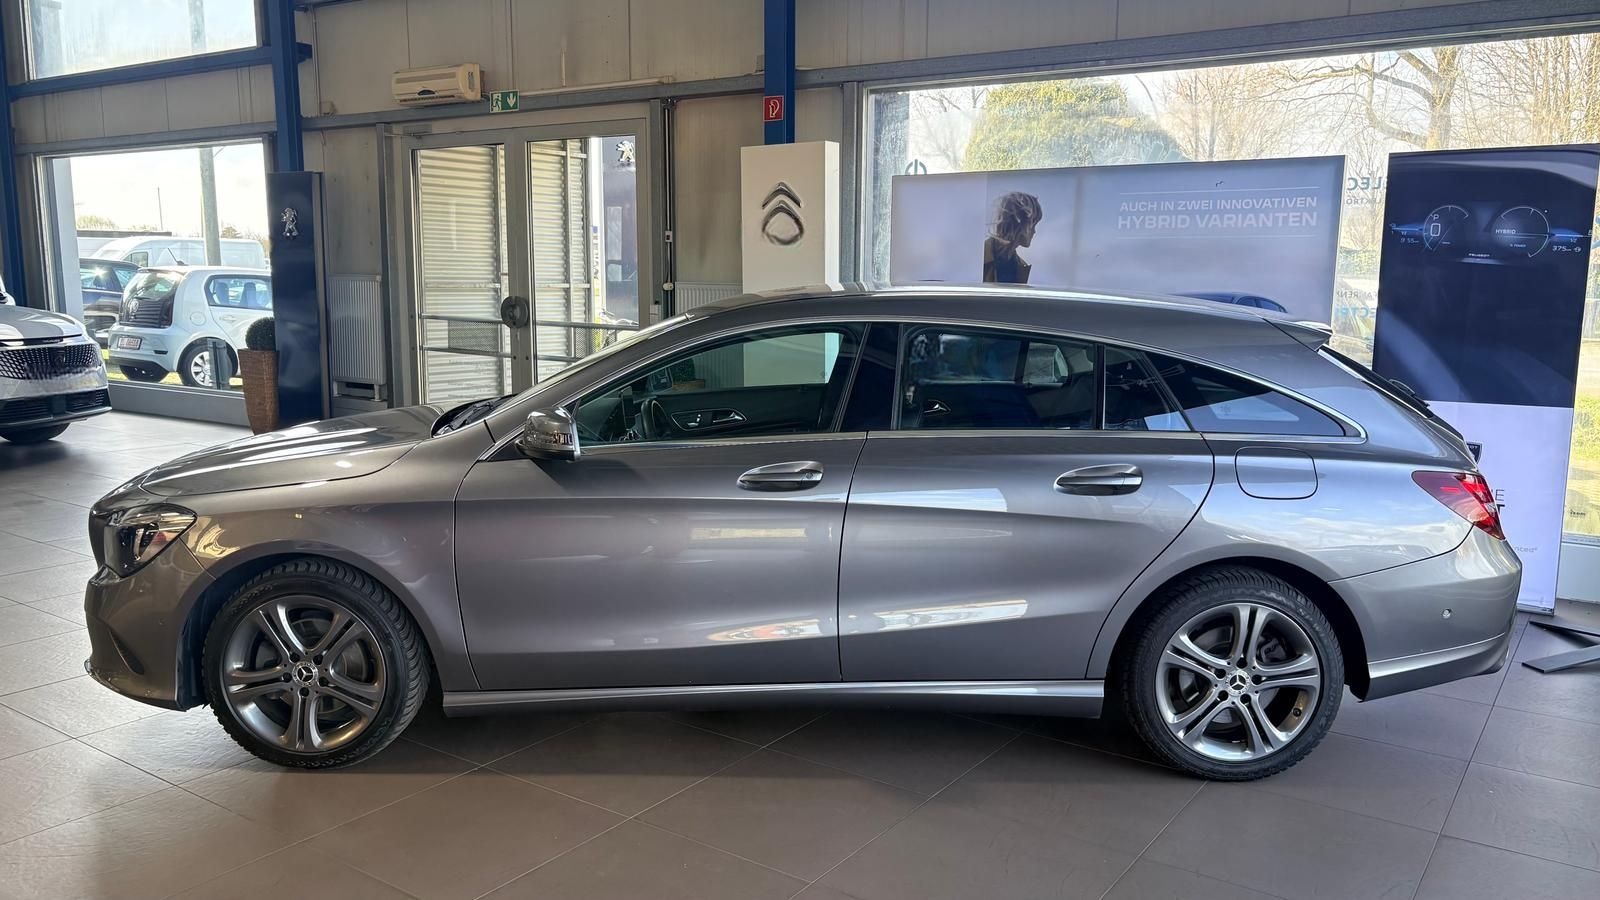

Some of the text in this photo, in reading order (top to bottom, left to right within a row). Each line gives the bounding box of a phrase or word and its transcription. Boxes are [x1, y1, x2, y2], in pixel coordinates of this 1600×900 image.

[1120, 196, 1317, 212] AUCH IN ZWEI INNOVATIVEN
[1118, 211, 1317, 229] HYBRID VARIANTEN
